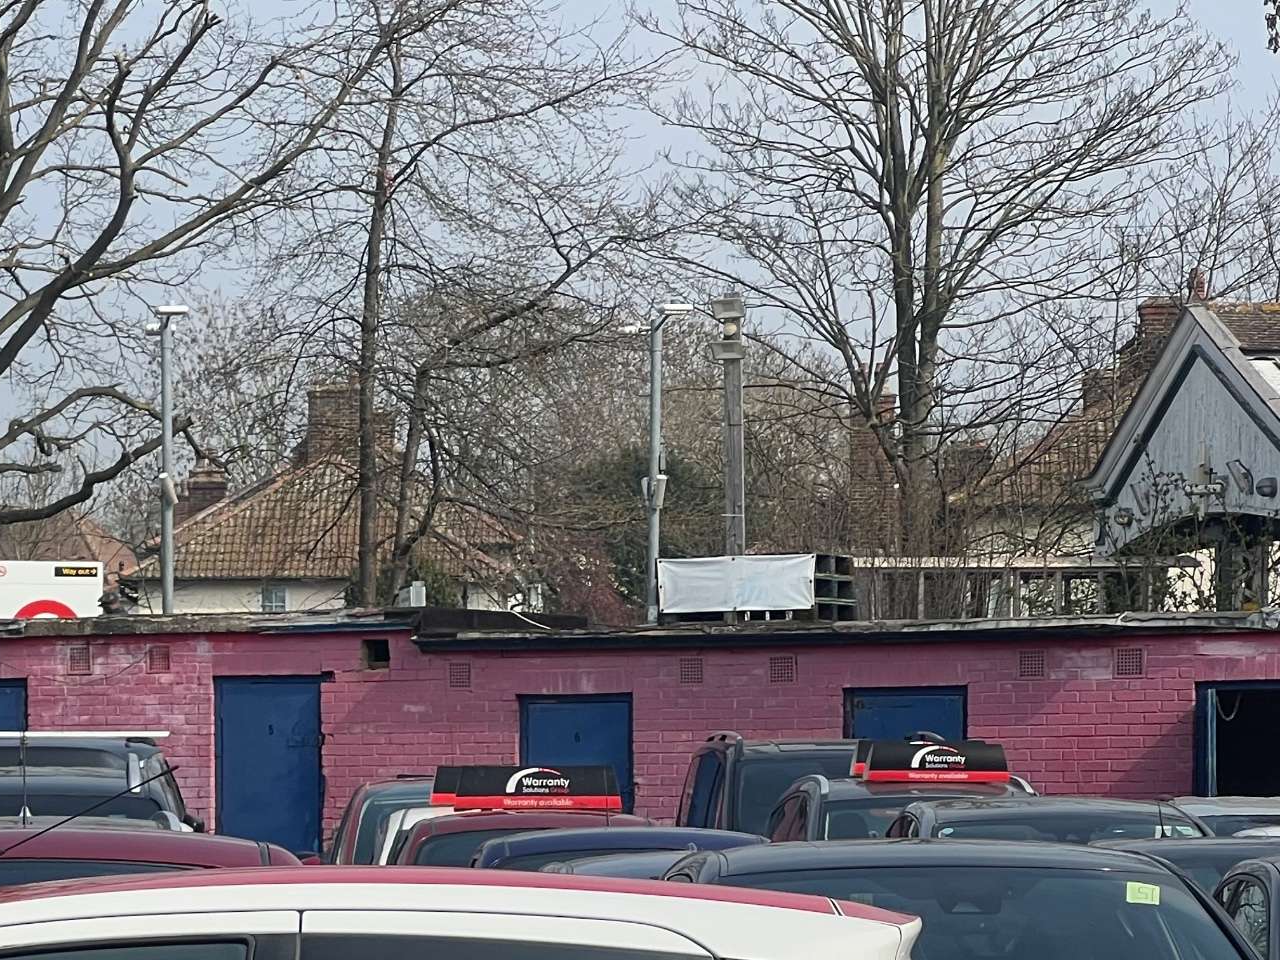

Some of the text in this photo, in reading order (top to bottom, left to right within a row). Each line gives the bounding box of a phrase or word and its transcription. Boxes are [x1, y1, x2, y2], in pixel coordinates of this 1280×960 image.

[925, 754, 966, 764] Warranty
[522, 777, 570, 788] Warranty
[503, 798, 574, 807] Warranty available
